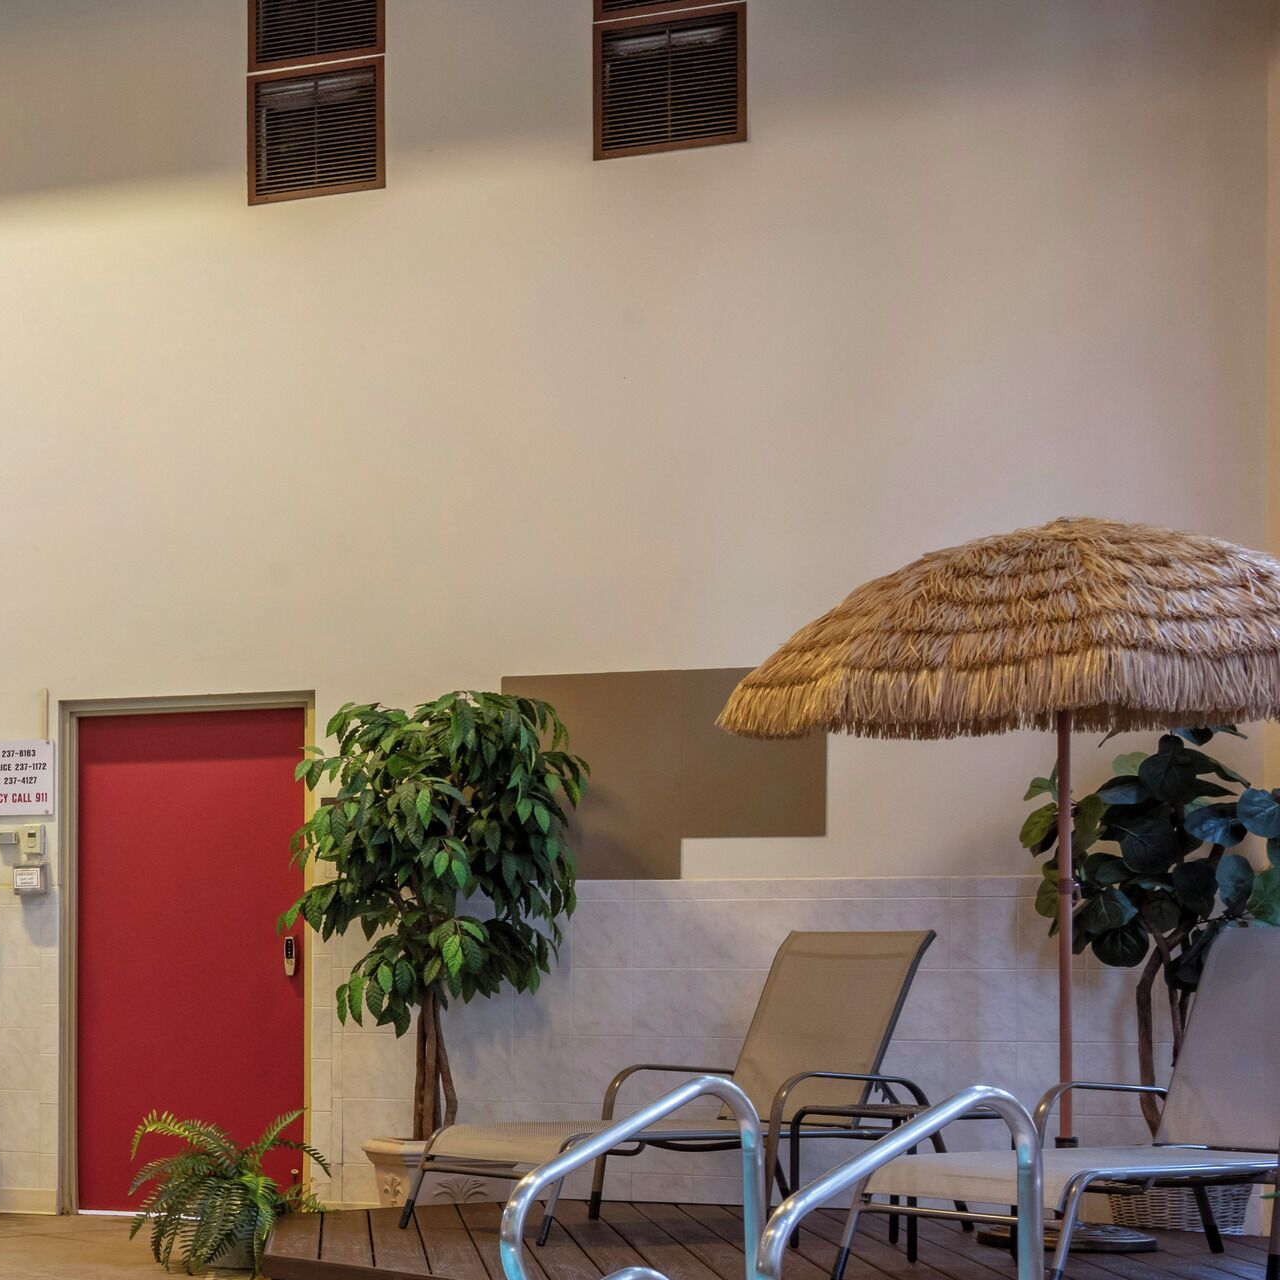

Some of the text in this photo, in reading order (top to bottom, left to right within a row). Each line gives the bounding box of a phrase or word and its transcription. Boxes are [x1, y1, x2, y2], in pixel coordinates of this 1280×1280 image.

[2, 750, 36, 758] 237-8163
[15, 763, 47, 771] 237-1172
[12, 793, 32, 803] CALL
[36, 793, 48, 802] 911
